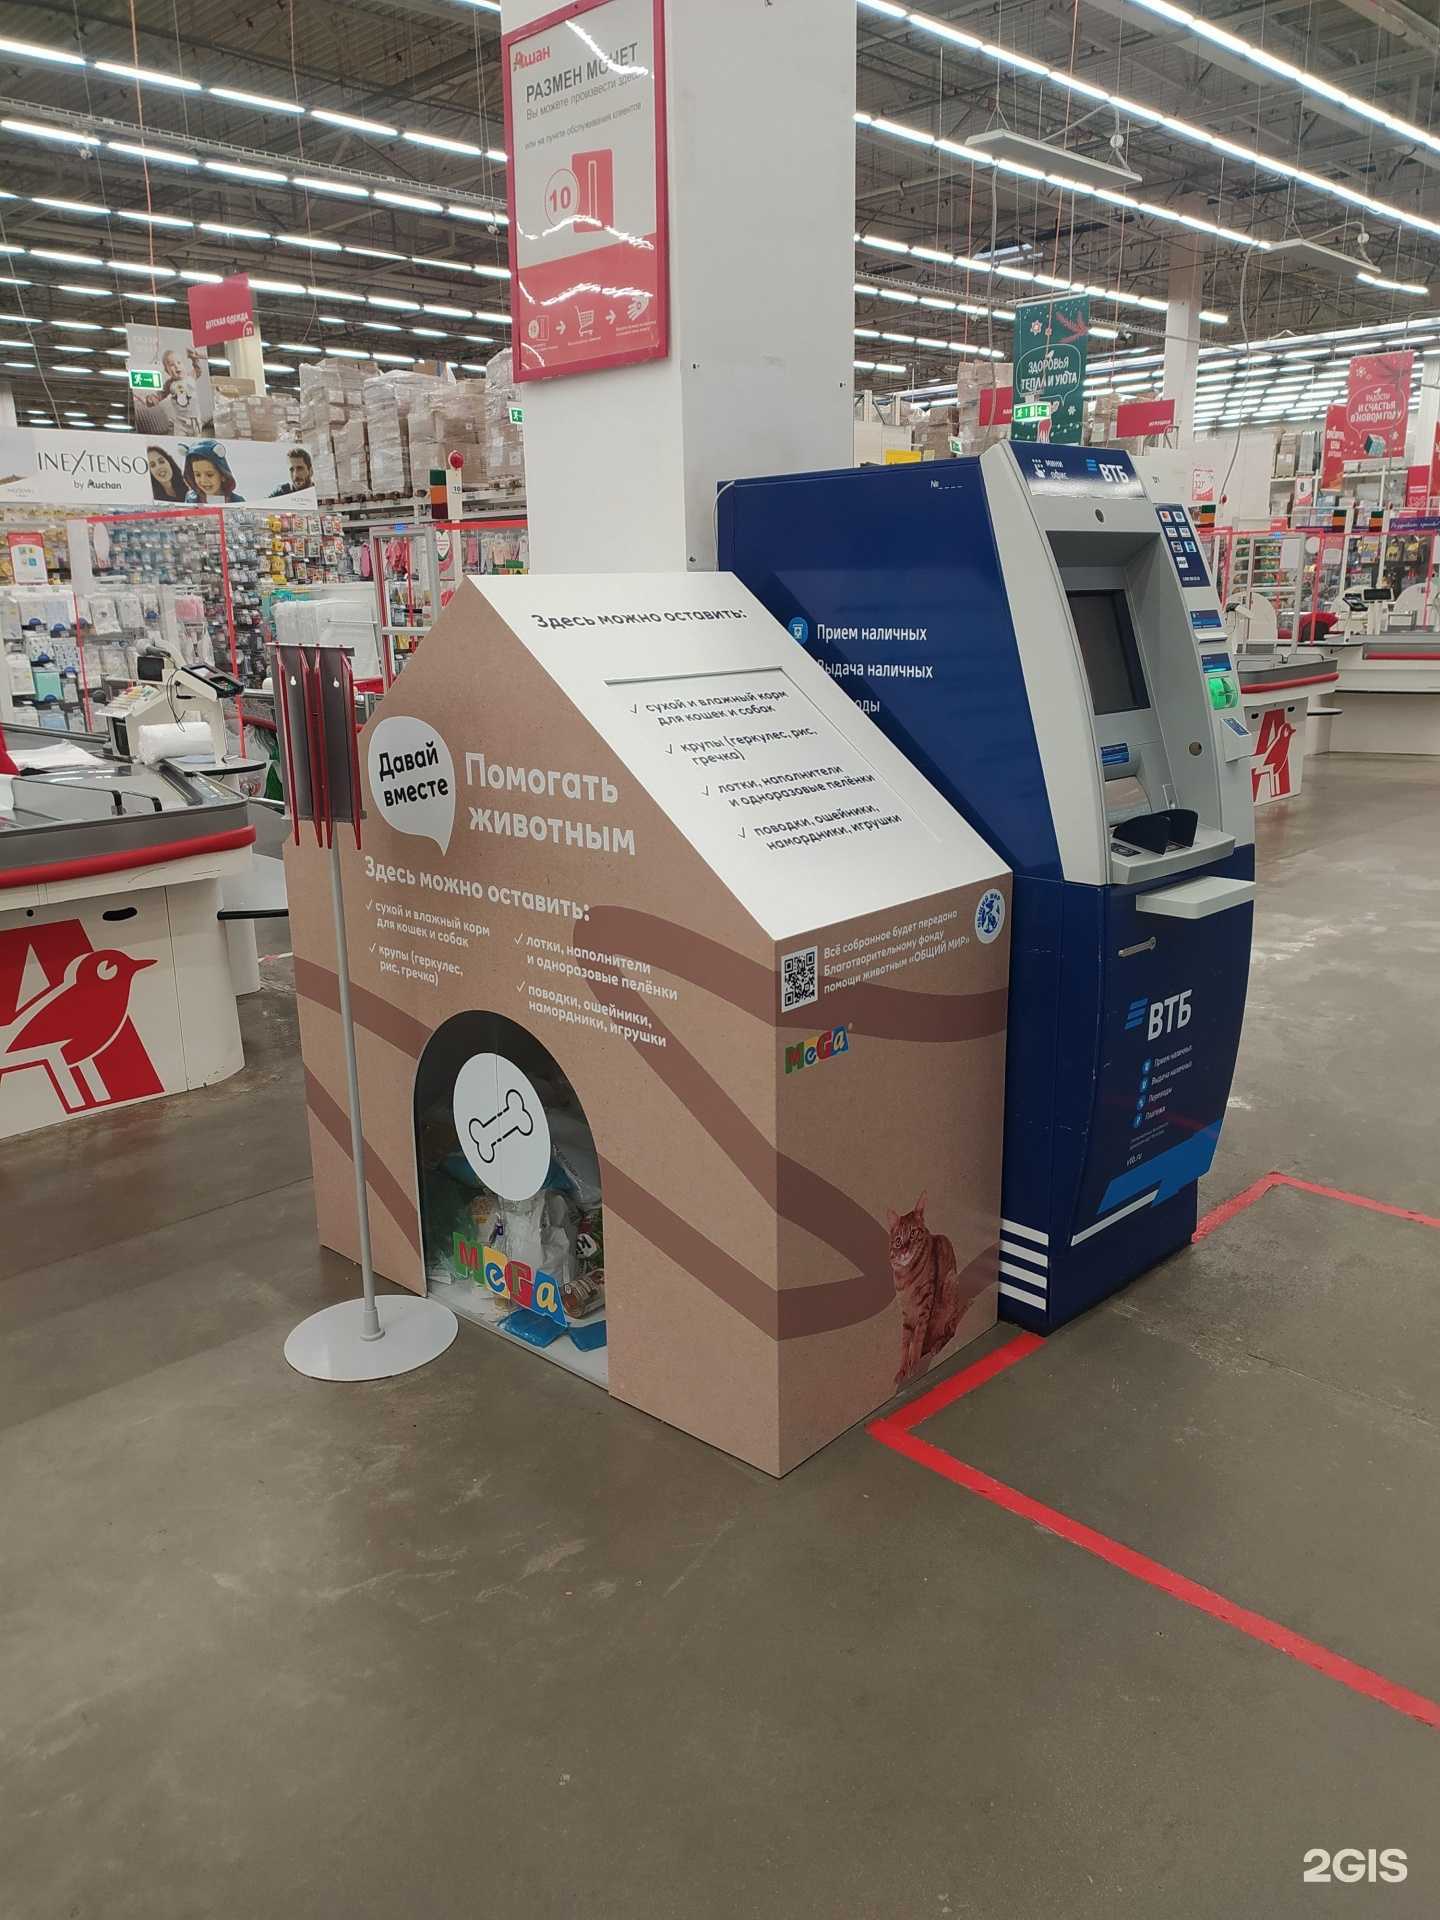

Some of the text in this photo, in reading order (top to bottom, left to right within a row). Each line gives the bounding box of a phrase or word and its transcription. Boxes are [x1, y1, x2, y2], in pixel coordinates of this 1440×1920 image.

[527, 65, 582, 103] РАЗМЕН
[527, 109, 538, 120] Вы
[540, 98, 569, 115] можете
[570, 80, 617, 104] произвести
[550, 187, 571, 212] 10
[1048, 375, 1054, 387] И
[74, 479, 122, 490] by Auchan
[1099, 463, 1129, 483] ВТБ
[531, 607, 748, 630] Здесь можно оставить:
[817, 624, 928, 643] Прием наличных
[868, 663, 934, 678] наличных
[645, 689, 789, 714] сухой и влажный корм
[658, 703, 776, 727] для кошек и собак
[680, 725, 818, 755] крупы (геркулес, рис,
[378, 741, 439, 782] Давай
[692, 749, 746, 767] гречка)
[384, 777, 449, 807] вместе
[464, 752, 618, 803] Помогать
[718, 764, 843, 795] лотки, наполнители
[729, 773, 876, 808] и одноразовые пелёнки
[468, 806, 636, 855] животным
[754, 803, 881, 838] поводки, ошейники,
[767, 813, 903, 851] намордники, игрушки
[364, 856, 590, 922] Здесь можно оставить:
[375, 901, 490, 936] сухой и влажный корм
[376, 918, 469, 947] для кошек и собак
[824, 910, 958, 960] Всё собранное будет передано
[379, 944, 464, 977] крупы (геркулес,
[525, 935, 651, 975] лотки, наполнители
[824, 930, 945, 976] Благотворительному фонду
[824, 974, 861, 994] помощи
[863, 957, 908, 982] животным
[909, 940, 947, 964] «ОБЩИЙ
[380, 960, 440, 986] рис, гречка)
[527, 955, 678, 1001] и одноразовые пелёнки
[528, 985, 652, 1029] поводки, ошейники,
[528, 1001, 667, 1048] намордники, игрушки
[1148, 989, 1192, 1041] ВТБ
